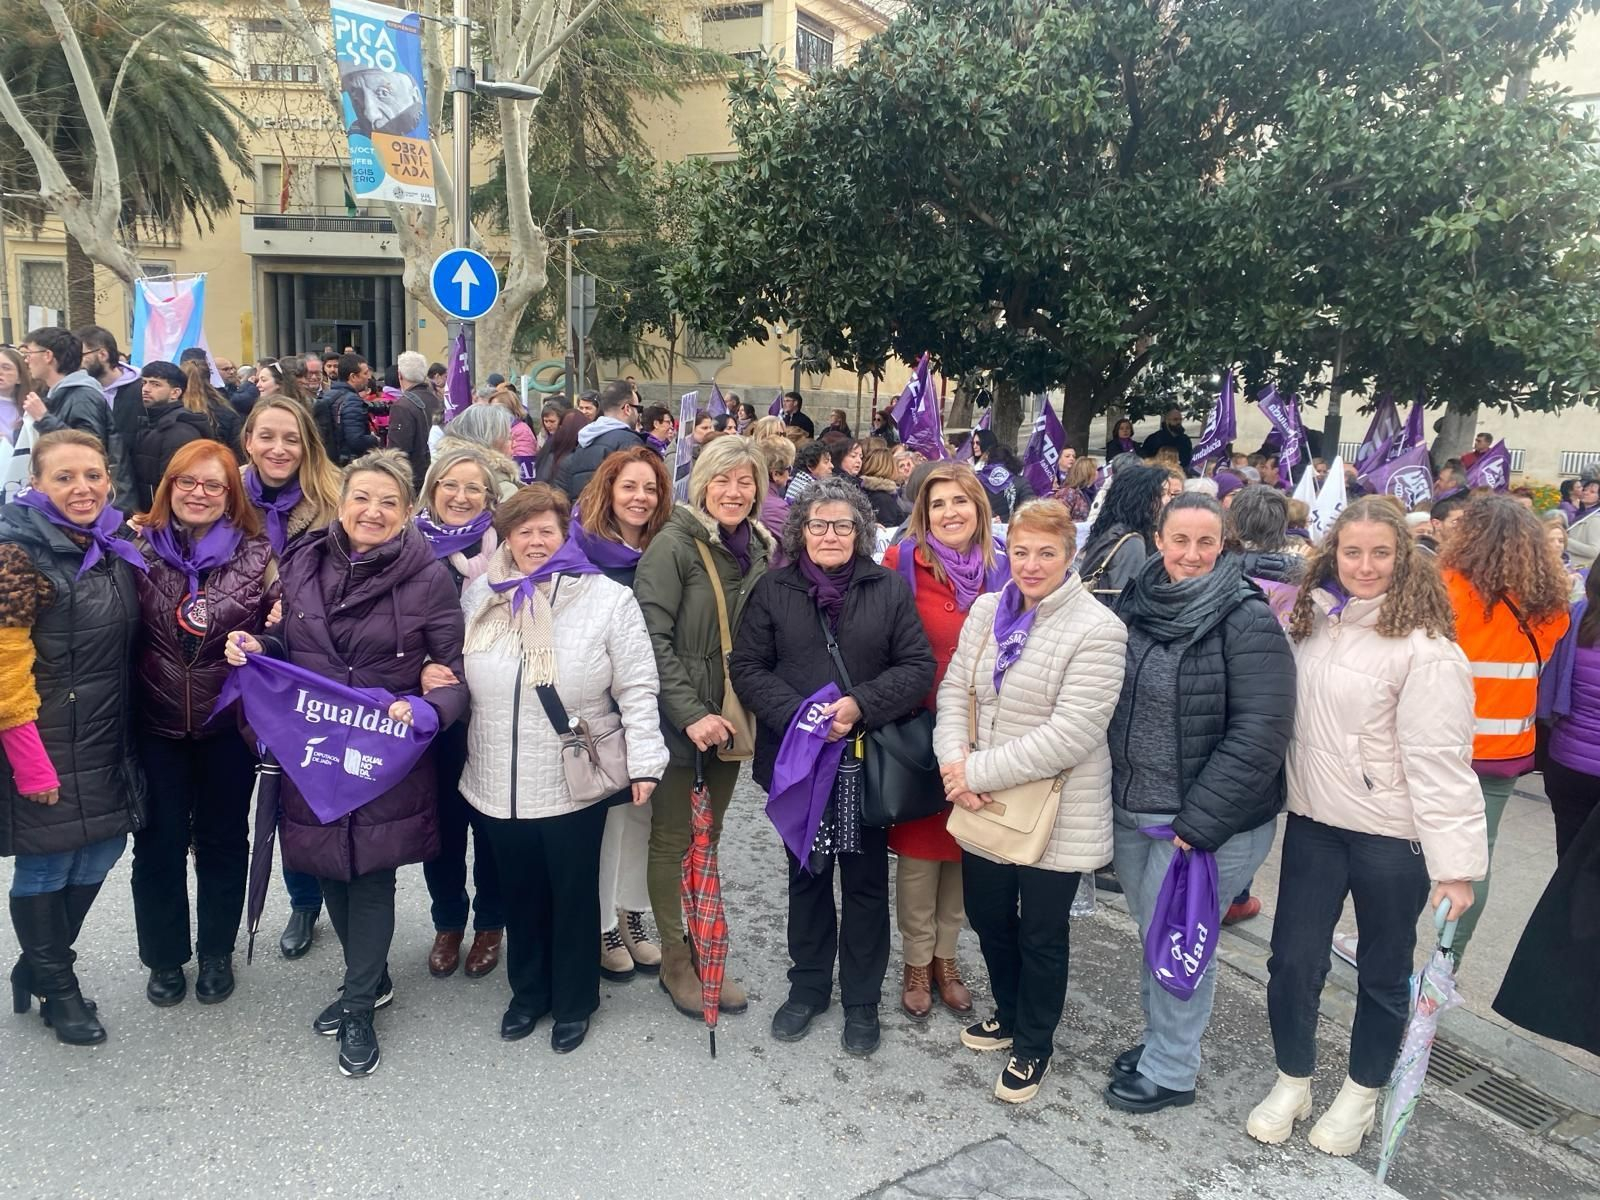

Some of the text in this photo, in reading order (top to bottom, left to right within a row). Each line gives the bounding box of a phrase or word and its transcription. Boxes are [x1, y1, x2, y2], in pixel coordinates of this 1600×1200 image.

[334, 14, 396, 53] PICA
[391, 141, 428, 157] OBRA
[391, 163, 430, 179] TADA
[293, 688, 410, 739] Igualdad
[361, 754, 384, 766] IGUAL
